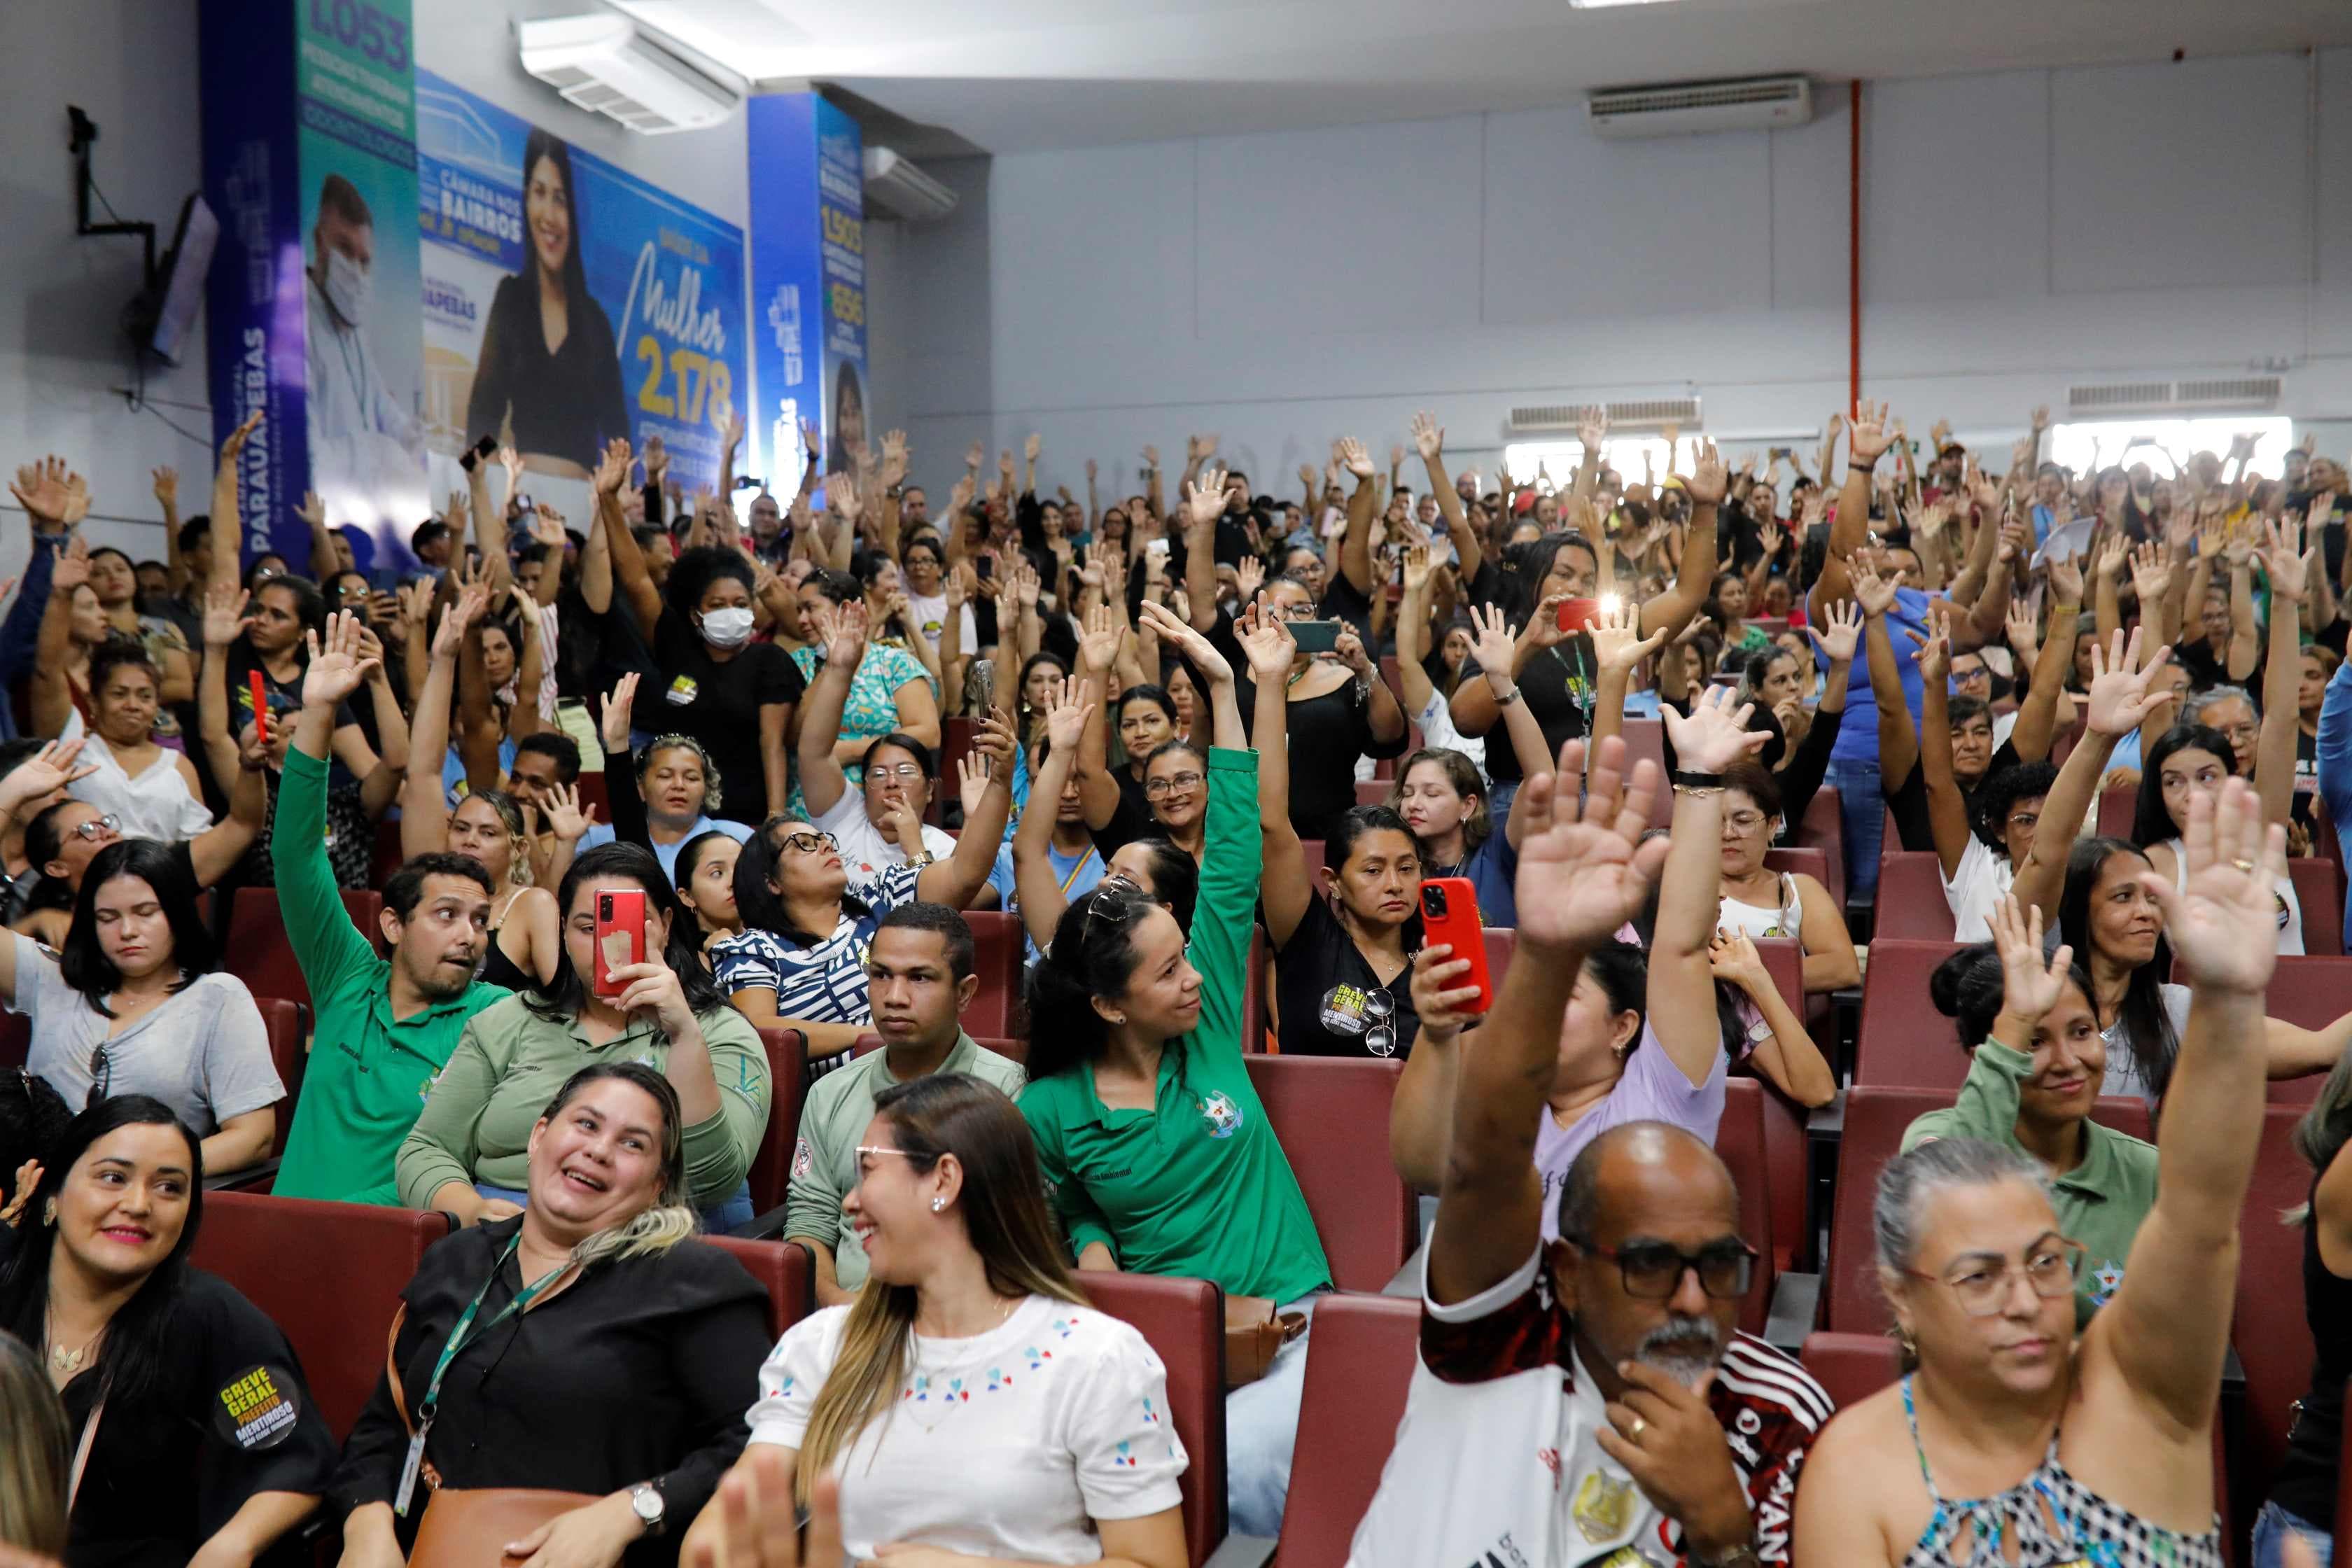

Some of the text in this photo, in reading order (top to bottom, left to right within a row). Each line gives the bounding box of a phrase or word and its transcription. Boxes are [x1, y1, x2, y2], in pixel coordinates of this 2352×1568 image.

[440, 189, 523, 244] BAIRROS
[616, 240, 726, 354] Mulher
[1333, 994, 1364, 1013] GERAL
[1337, 984, 1366, 1004] GREVE
[1323, 1009, 1362, 1029] MENTIROSO
[220, 1366, 270, 1405] GREVE
[227, 1381, 278, 1418] GERAL
[235, 1400, 293, 1442] MENTIROSO
[237, 1394, 281, 1427] PREFEITO
